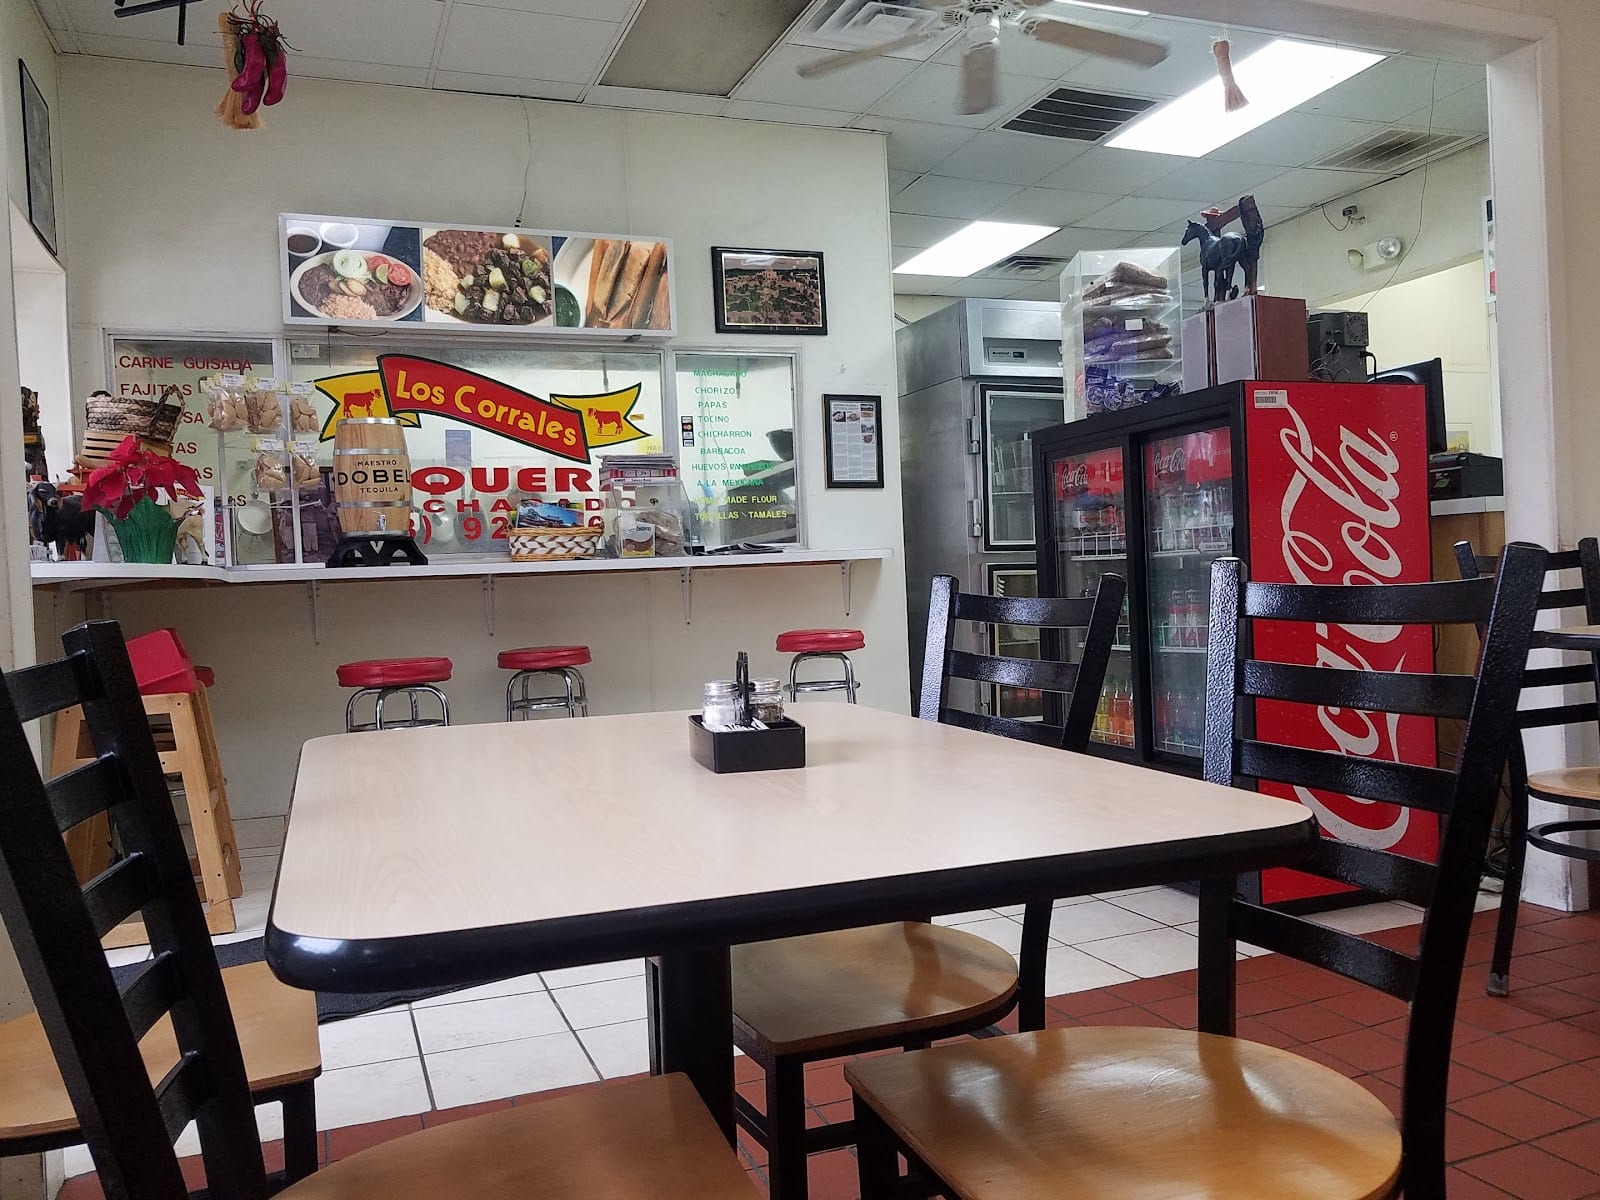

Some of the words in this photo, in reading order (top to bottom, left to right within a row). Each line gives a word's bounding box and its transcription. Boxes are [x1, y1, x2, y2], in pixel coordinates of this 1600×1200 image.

[119, 356, 174, 368] CARNE
[183, 358, 252, 370] GUISADA
[121, 384, 192, 396] FAJITAS
[396, 370, 445, 405] Los
[454, 385, 577, 446] Corrales
[338, 469, 411, 486] DOBEL
[752, 495, 777, 503] FLOUR
[748, 510, 787, 519] TAMALES
[1280, 402, 1410, 850] Cca-Cola
